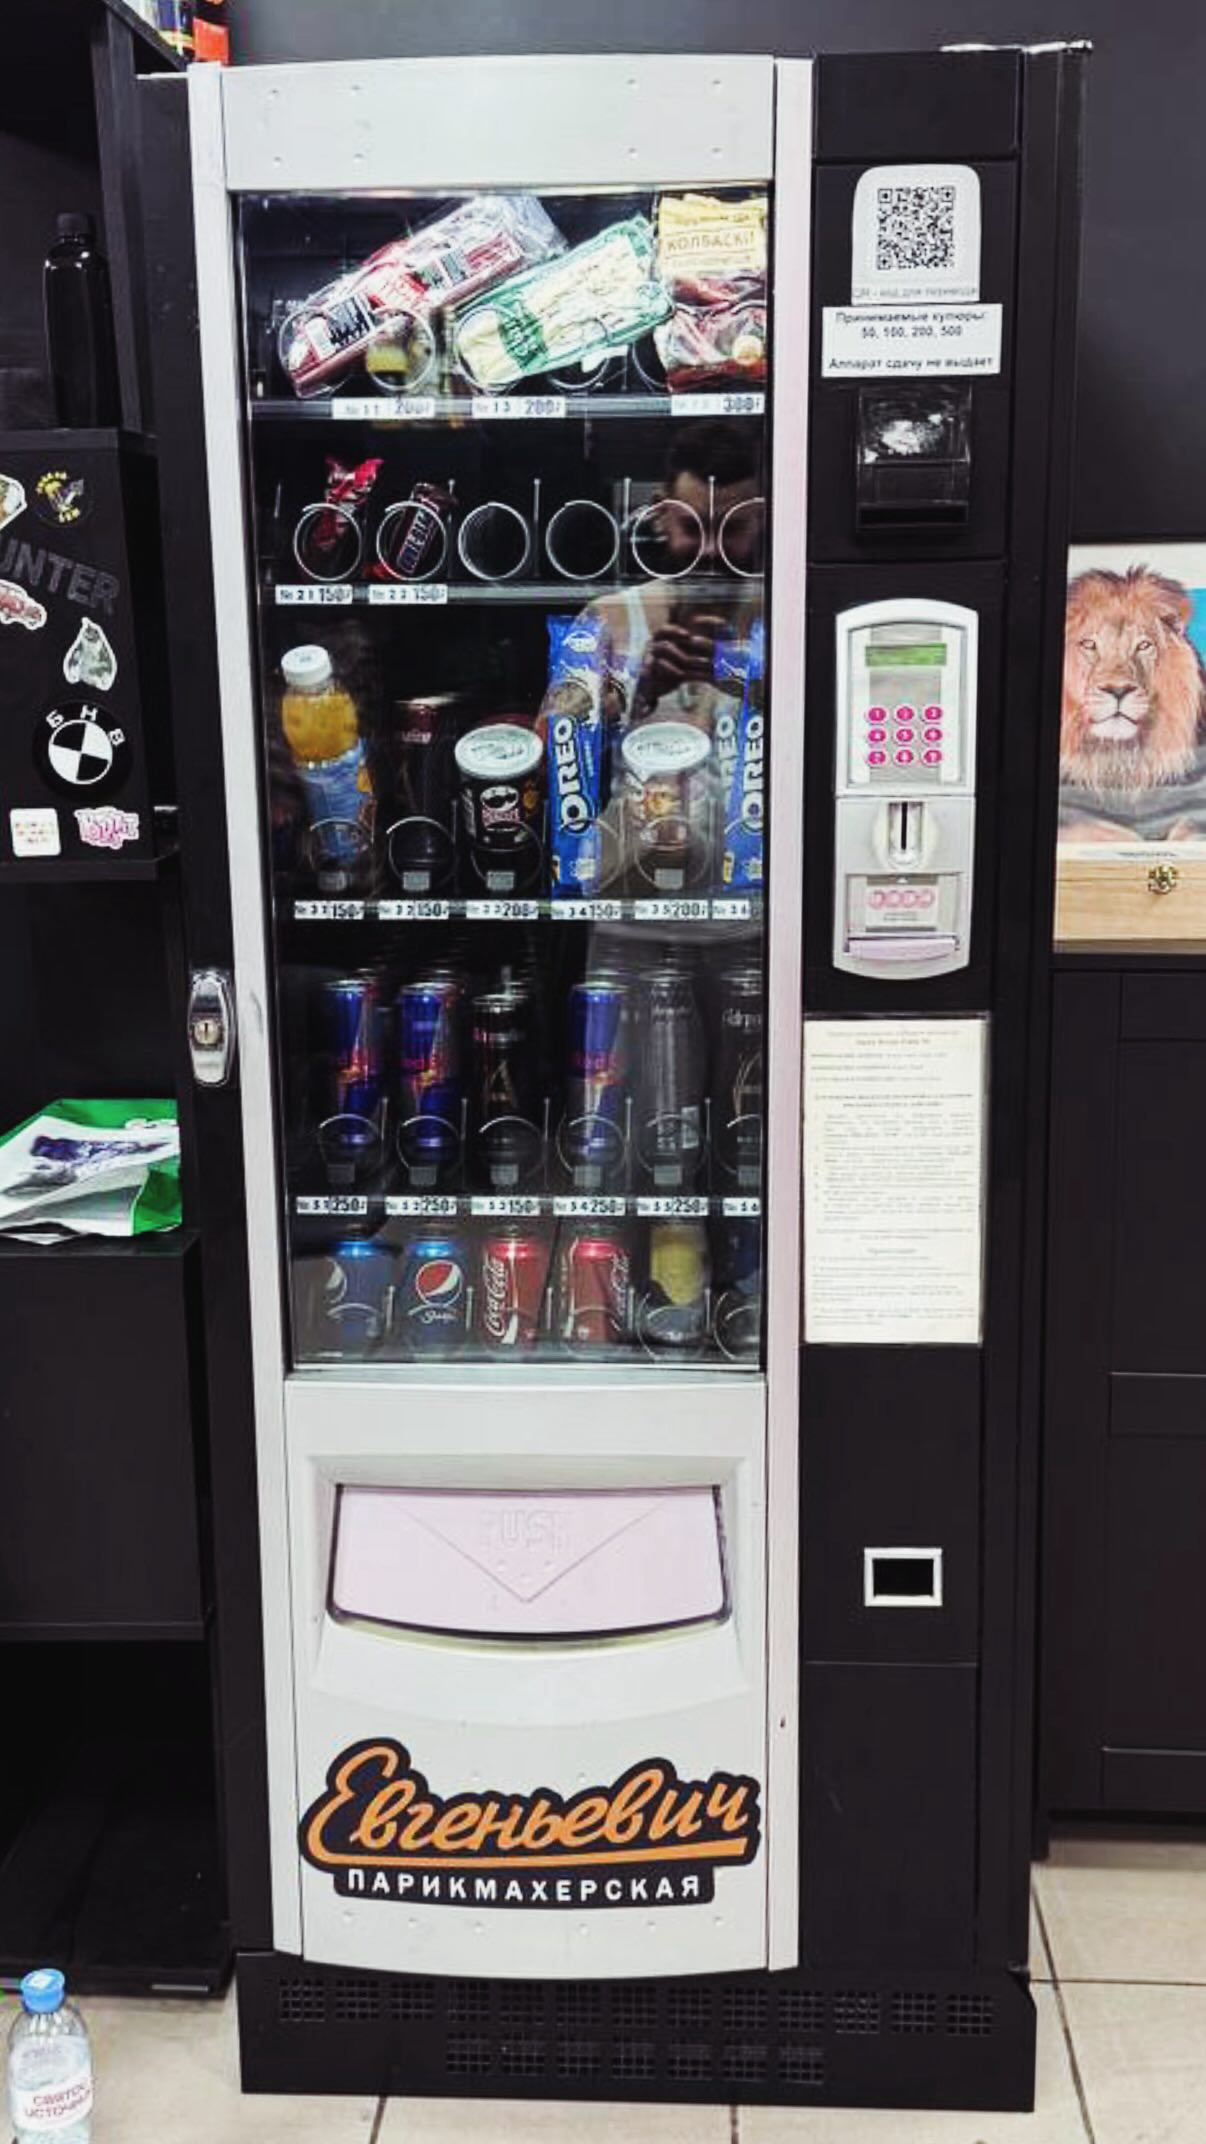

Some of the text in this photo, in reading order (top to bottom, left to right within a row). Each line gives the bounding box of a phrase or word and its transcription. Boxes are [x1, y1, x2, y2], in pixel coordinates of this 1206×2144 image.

[836, 311, 928, 325] Принимаемые
[941, 325, 962, 337] 500
[829, 358, 882, 370] Аппарат
[885, 357, 922, 371] сдачу
[926, 358, 941, 368] не
[553, 717, 588, 831] OREO
[307, 1745, 750, 1860] Евгеньевич
[347, 1867, 701, 1903] ПАРИКМАХЕРСКАЯ
